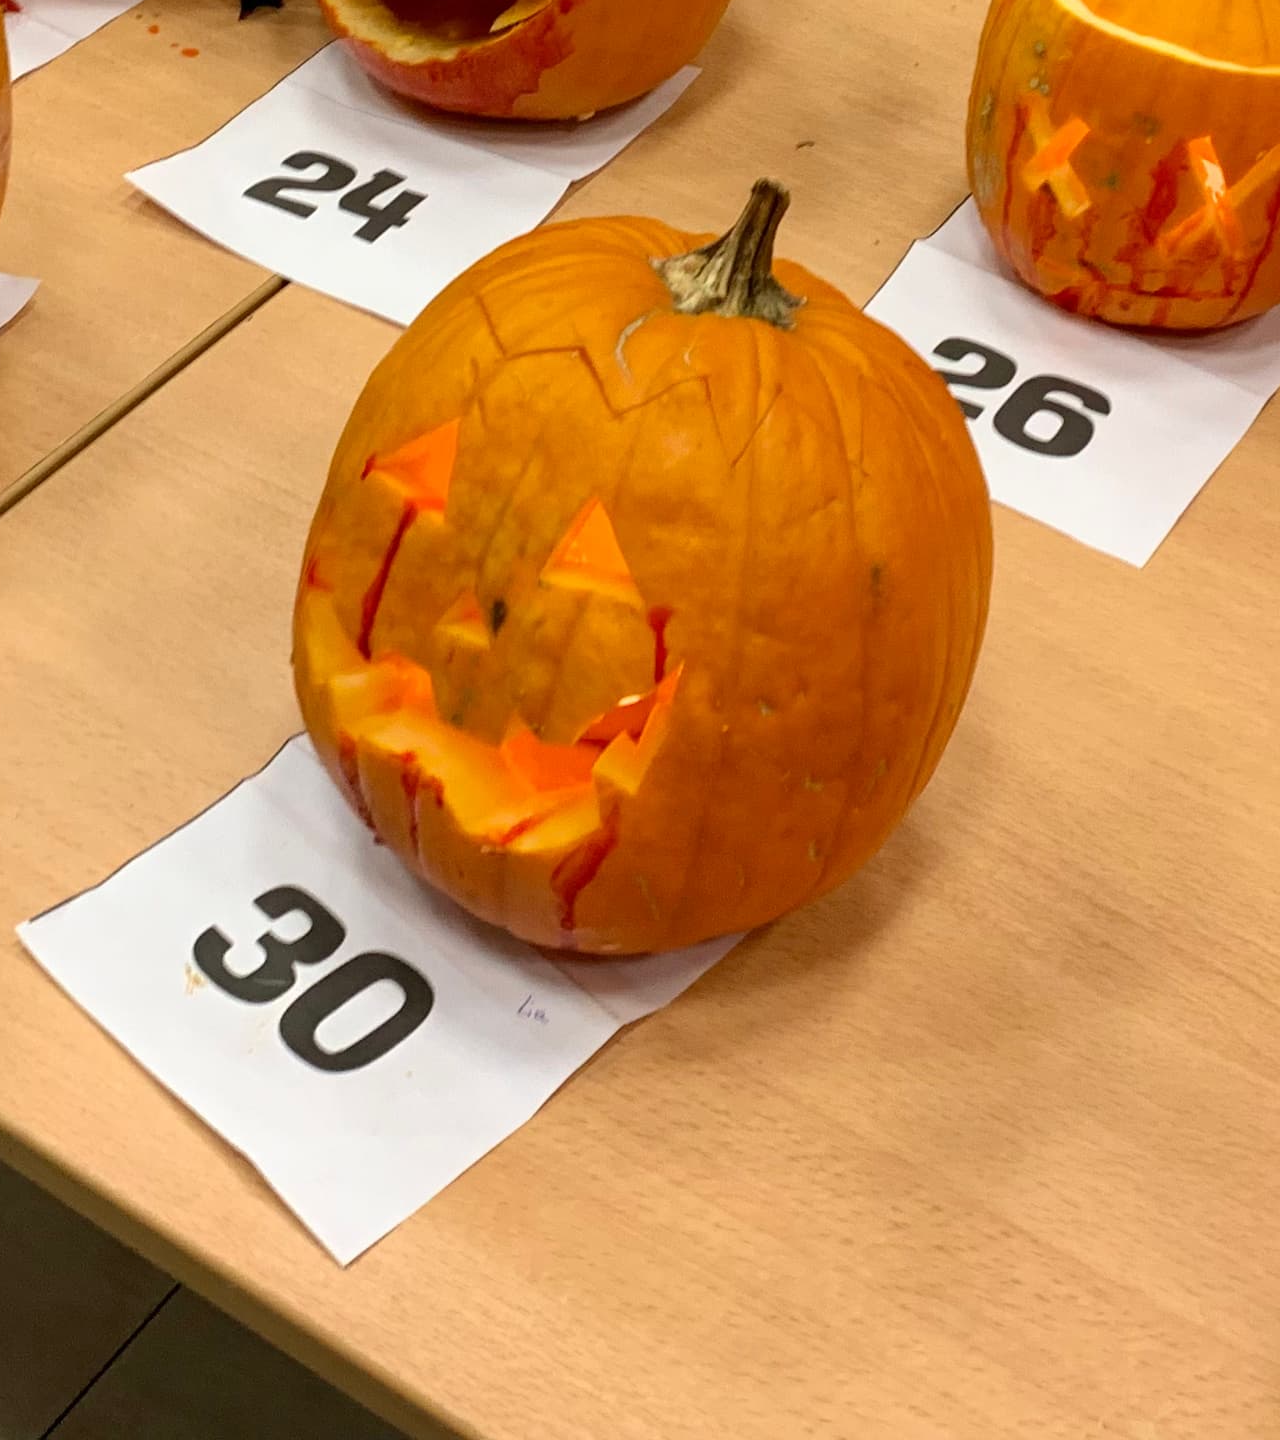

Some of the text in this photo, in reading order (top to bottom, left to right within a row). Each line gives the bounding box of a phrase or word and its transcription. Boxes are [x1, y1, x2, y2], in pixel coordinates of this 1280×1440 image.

[243, 149, 429, 244] 24
[932, 337, 1112, 458] 26
[193, 884, 434, 1073] 30
